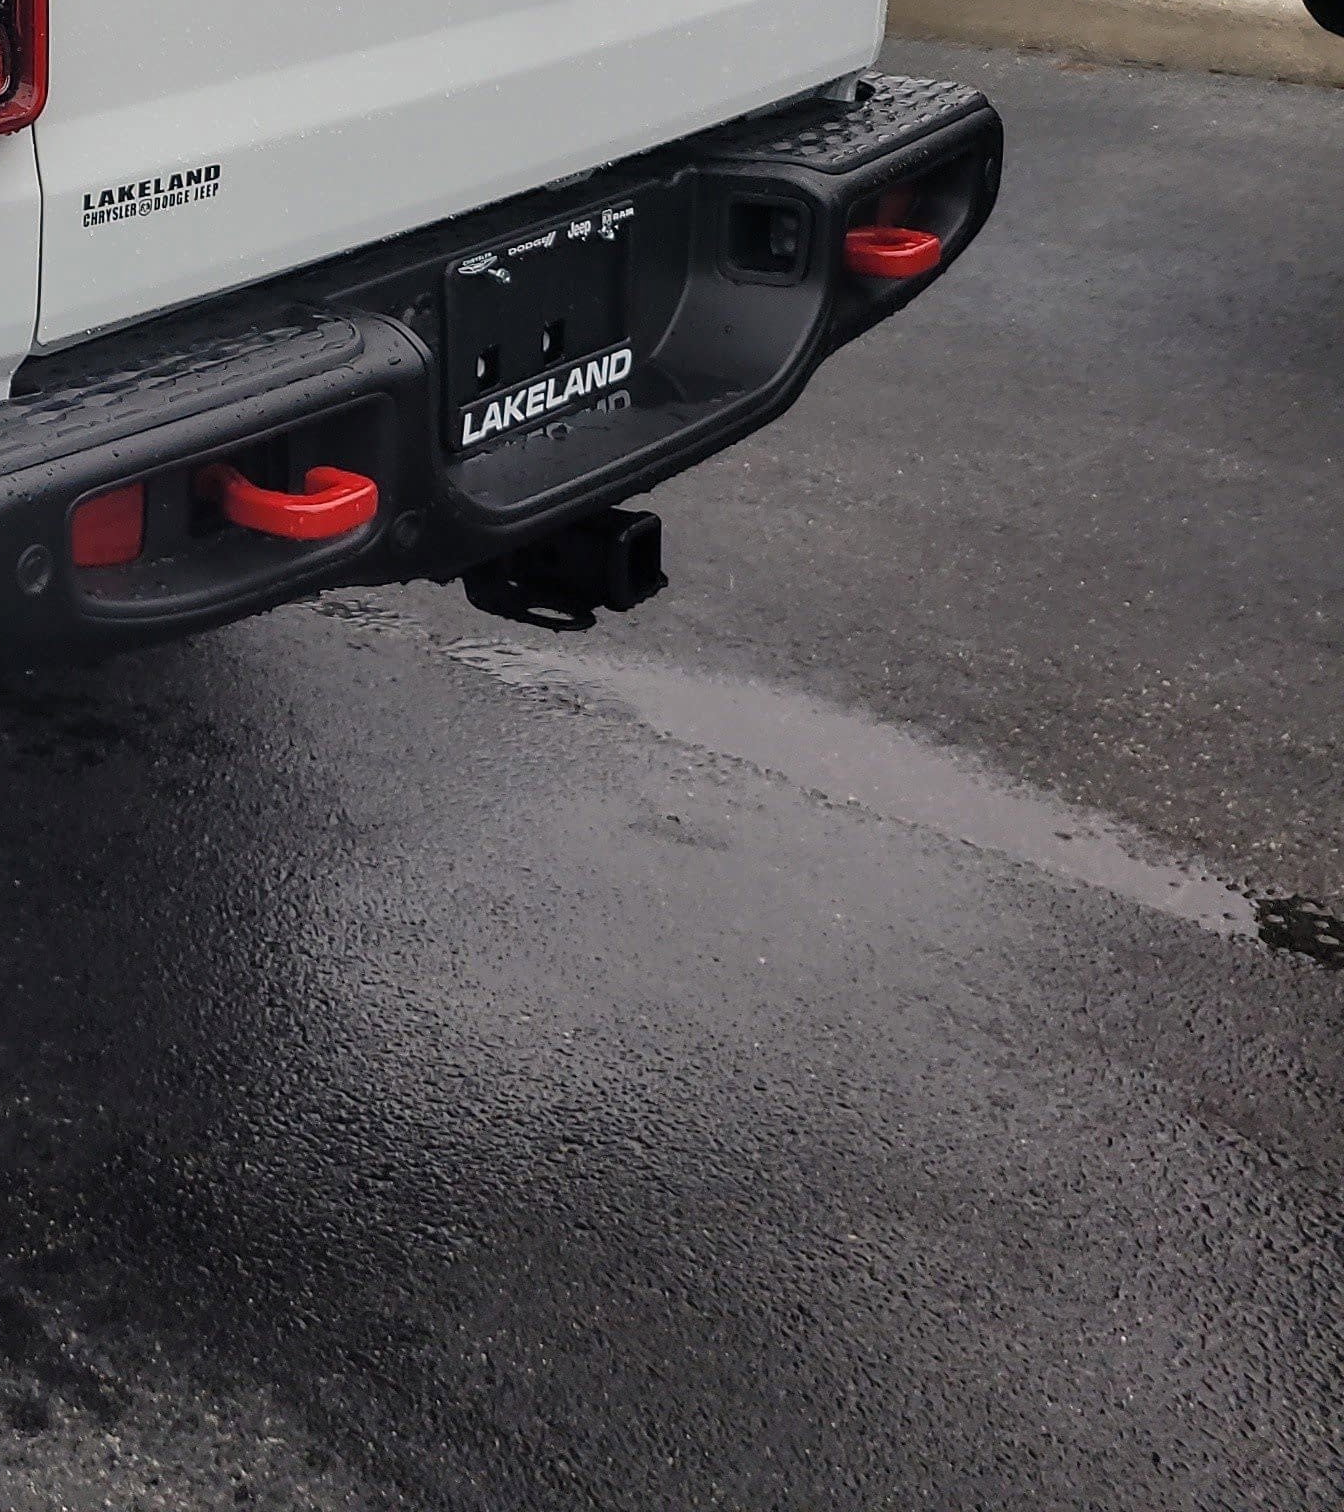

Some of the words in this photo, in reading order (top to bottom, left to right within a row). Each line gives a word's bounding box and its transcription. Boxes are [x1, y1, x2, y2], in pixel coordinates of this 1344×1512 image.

[82, 164, 221, 211] LAKELAND
[83, 203, 137, 228] CHRYSLER
[154, 190, 190, 211] DODGE
[194, 182, 219, 201] JEEP
[567, 220, 592, 239] Jeep
[612, 207, 635, 221] RAM
[462, 348, 632, 447] LAKELAND
